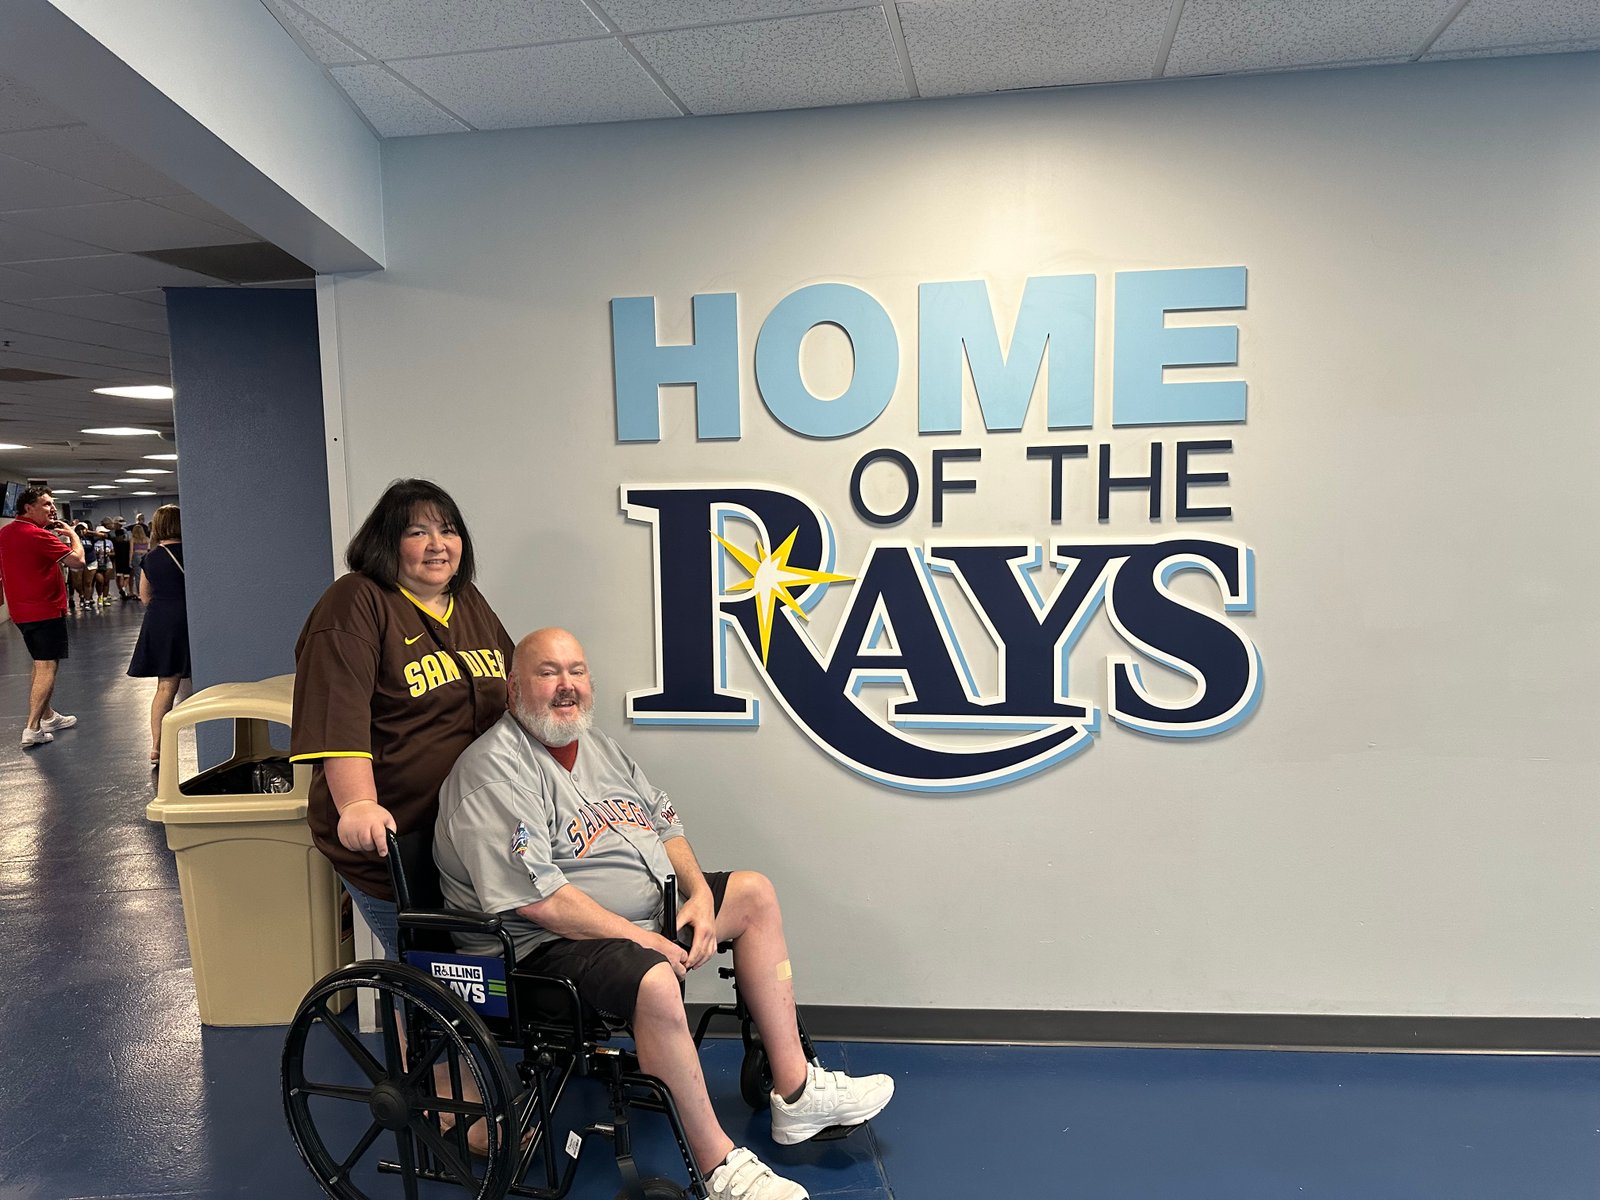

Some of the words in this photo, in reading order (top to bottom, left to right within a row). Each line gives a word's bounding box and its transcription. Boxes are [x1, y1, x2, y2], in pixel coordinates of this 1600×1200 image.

[611, 266, 1248, 442] HOME
[849, 447, 982, 526] OF
[1026, 439, 1234, 523] THE
[403, 651, 462, 698] SAN
[456, 649, 507, 681] DIEG
[620, 483, 1264, 794] RAYS
[442, 980, 486, 1004] AYS
